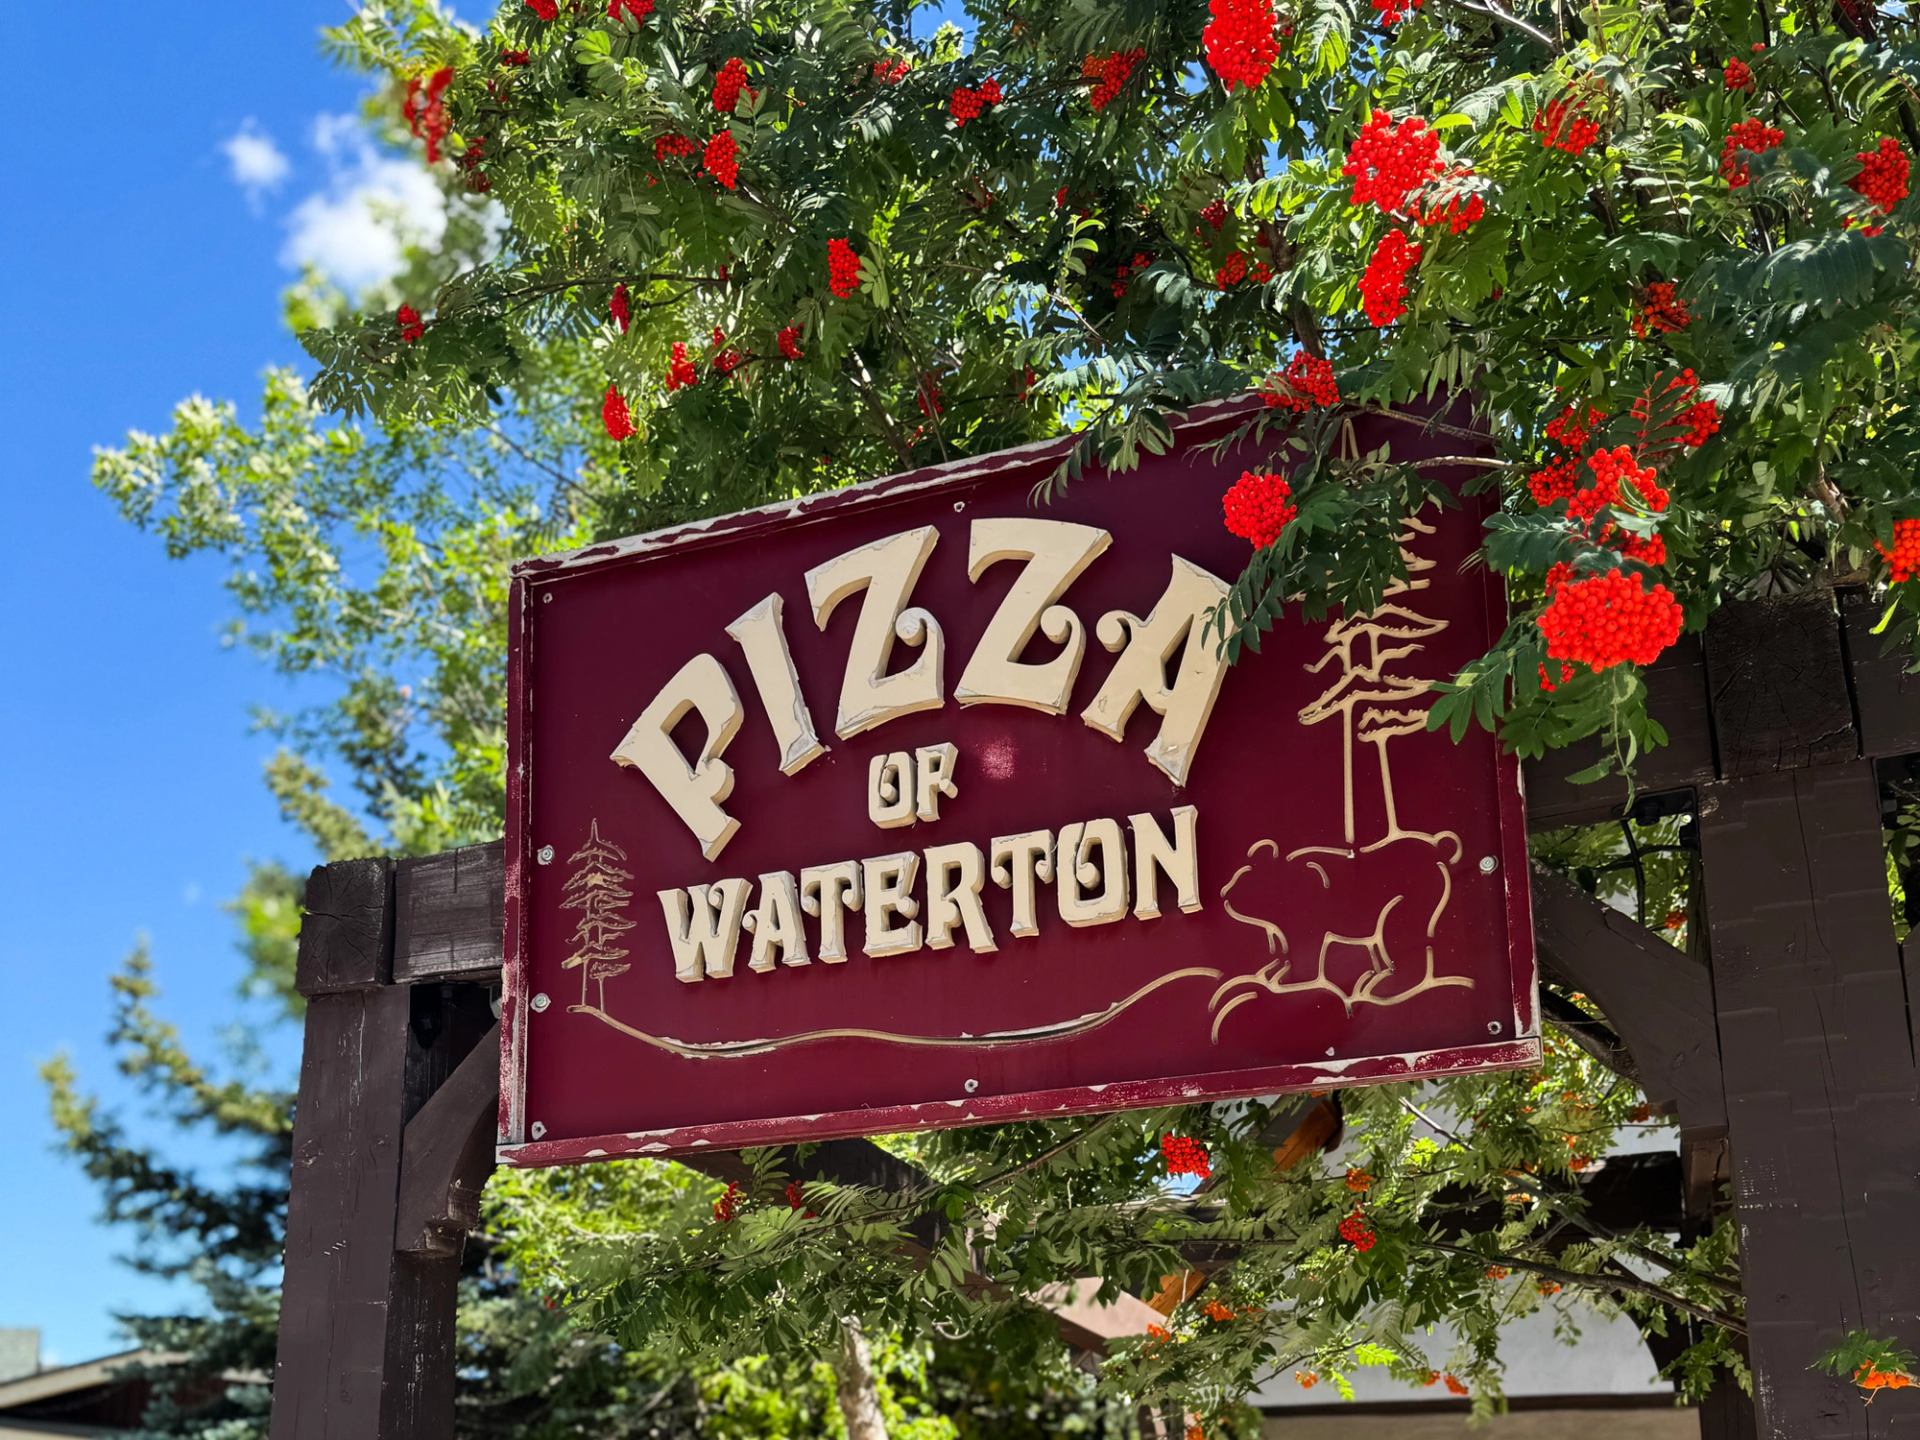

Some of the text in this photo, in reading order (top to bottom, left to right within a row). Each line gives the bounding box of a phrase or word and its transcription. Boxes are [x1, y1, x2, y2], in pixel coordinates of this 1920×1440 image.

[609, 517, 1234, 862] PIZZA
[868, 741, 958, 829] OF
[657, 805, 1203, 983] WATERTON
